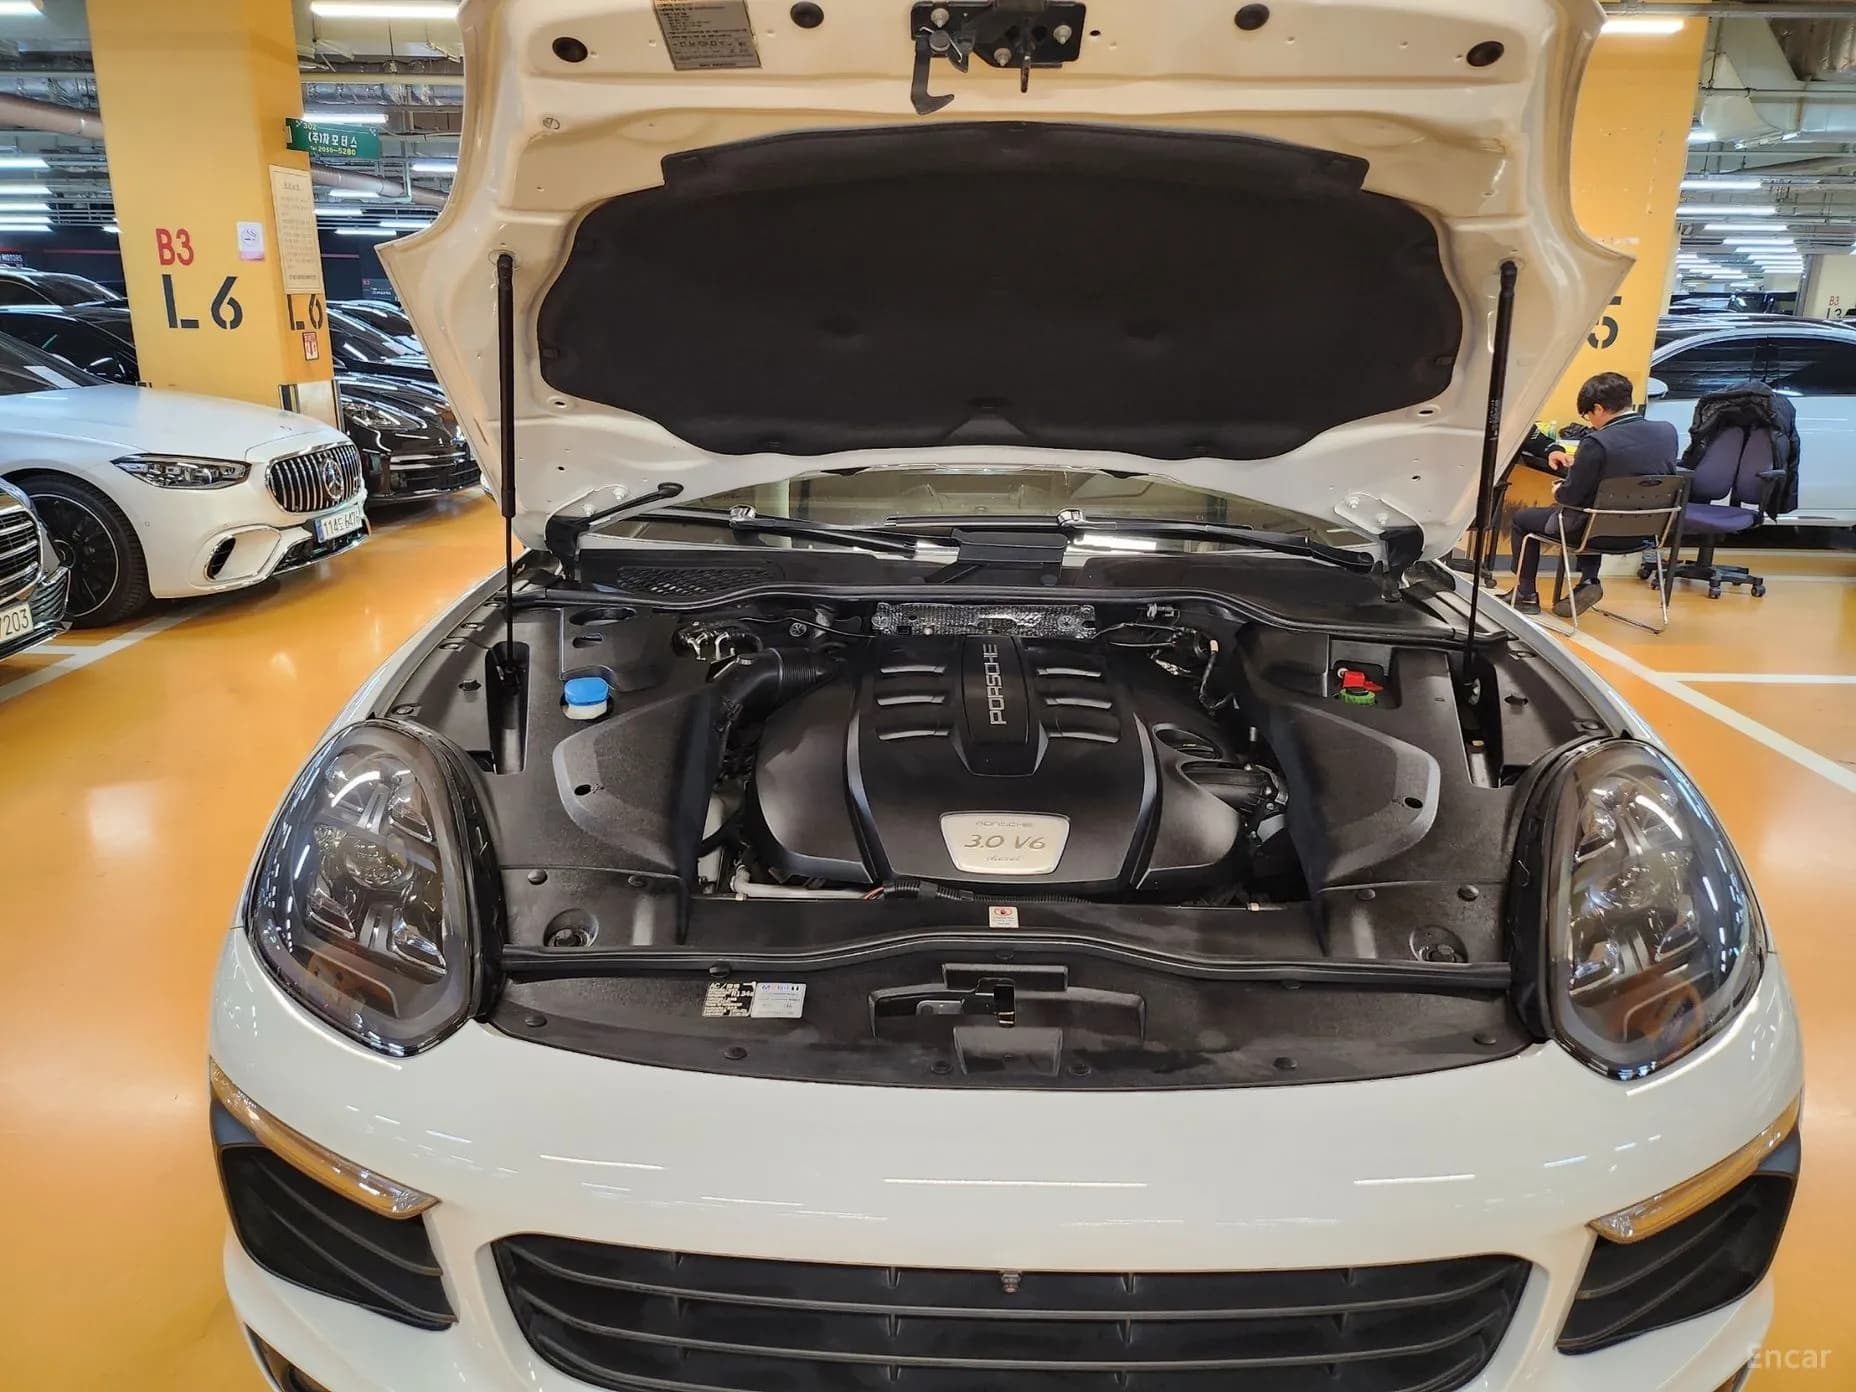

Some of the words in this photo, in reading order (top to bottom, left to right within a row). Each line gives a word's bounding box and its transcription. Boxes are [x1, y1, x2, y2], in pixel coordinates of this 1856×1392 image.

[156, 228, 194, 266] B3
[1829, 295, 1840, 306] B3
[0, 608, 29, 636] 203
[983, 643, 1007, 725] PORSCHE
[964, 834, 1005, 849] 3.0
[1014, 835, 1046, 850] V6
